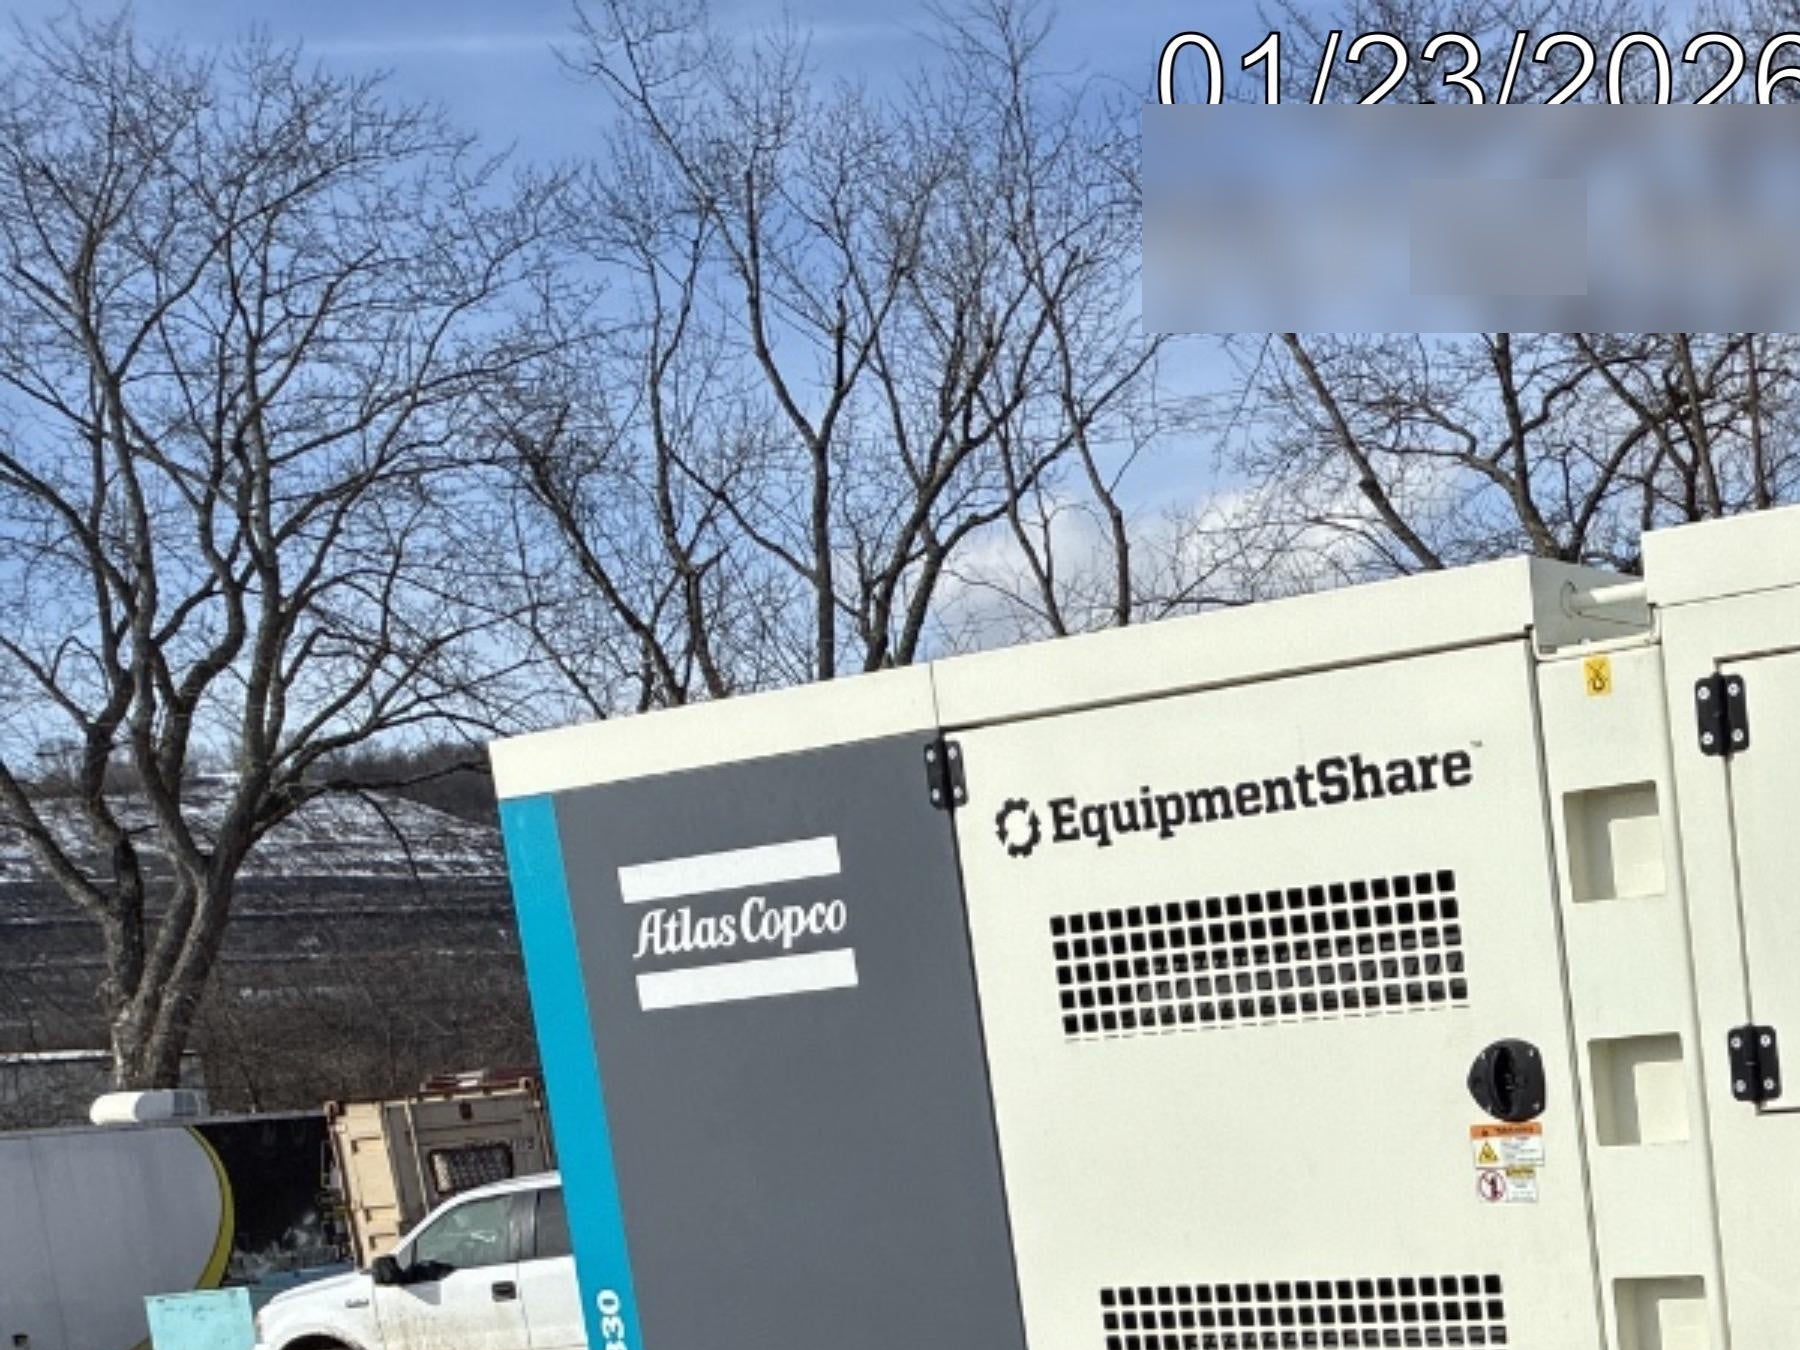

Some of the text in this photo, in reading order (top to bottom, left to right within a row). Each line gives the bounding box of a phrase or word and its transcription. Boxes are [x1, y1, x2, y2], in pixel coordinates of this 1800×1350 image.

[1049, 748, 1473, 848] EquipmentShare
[633, 895, 847, 960] Atlas Copco
